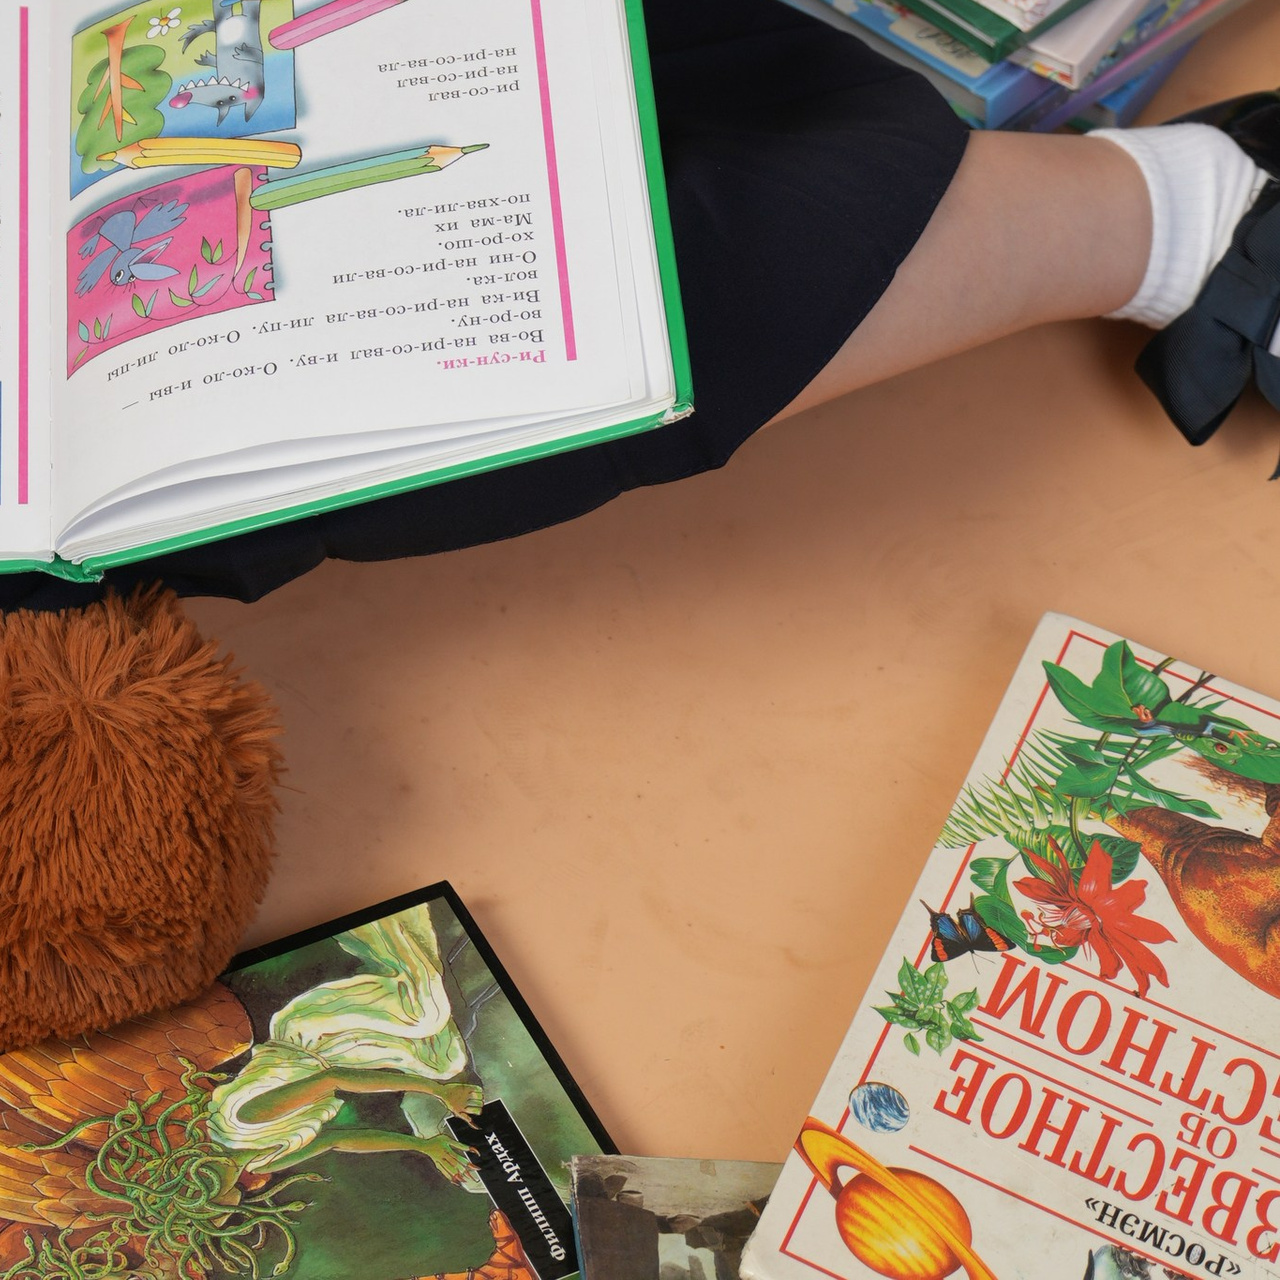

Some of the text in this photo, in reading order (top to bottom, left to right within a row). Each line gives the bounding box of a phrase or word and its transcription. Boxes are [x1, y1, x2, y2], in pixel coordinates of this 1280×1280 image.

[378, 47, 516, 72] на-ри-со-ва-ла
[397, 65, 518, 88] на-ри-со-вал
[428, 80, 520, 101] ри-со-вал
[398, 193, 530, 217] по-хва-ли-ла.
[434, 212, 533, 232] Ма-ма их
[438, 231, 534, 251] хо-ро-шо.
[333, 250, 536, 284] О-ни на-ри-со-ва-ли
[466, 270, 538, 286] вол-ка.
[451, 309, 542, 327] во-ро-ну.
[106, 289, 540, 381] Ви-ка на-ри-со-ва-ла ли-пу. О-ко-ло ли-пы
[488, 329, 544, 344] Во-ва
[350, 336, 477, 360] на-ри-со-вал
[290, 353, 338, 367] и-ву.
[437, 350, 546, 369] Ри-сун-ки.
[203, 362, 277, 384] О-ко-ло
[150, 380, 192, 401] и-вы
[1176, 1112, 1238, 1160] ОБ
[484, 1131, 567, 1262] Филипп Ардах
